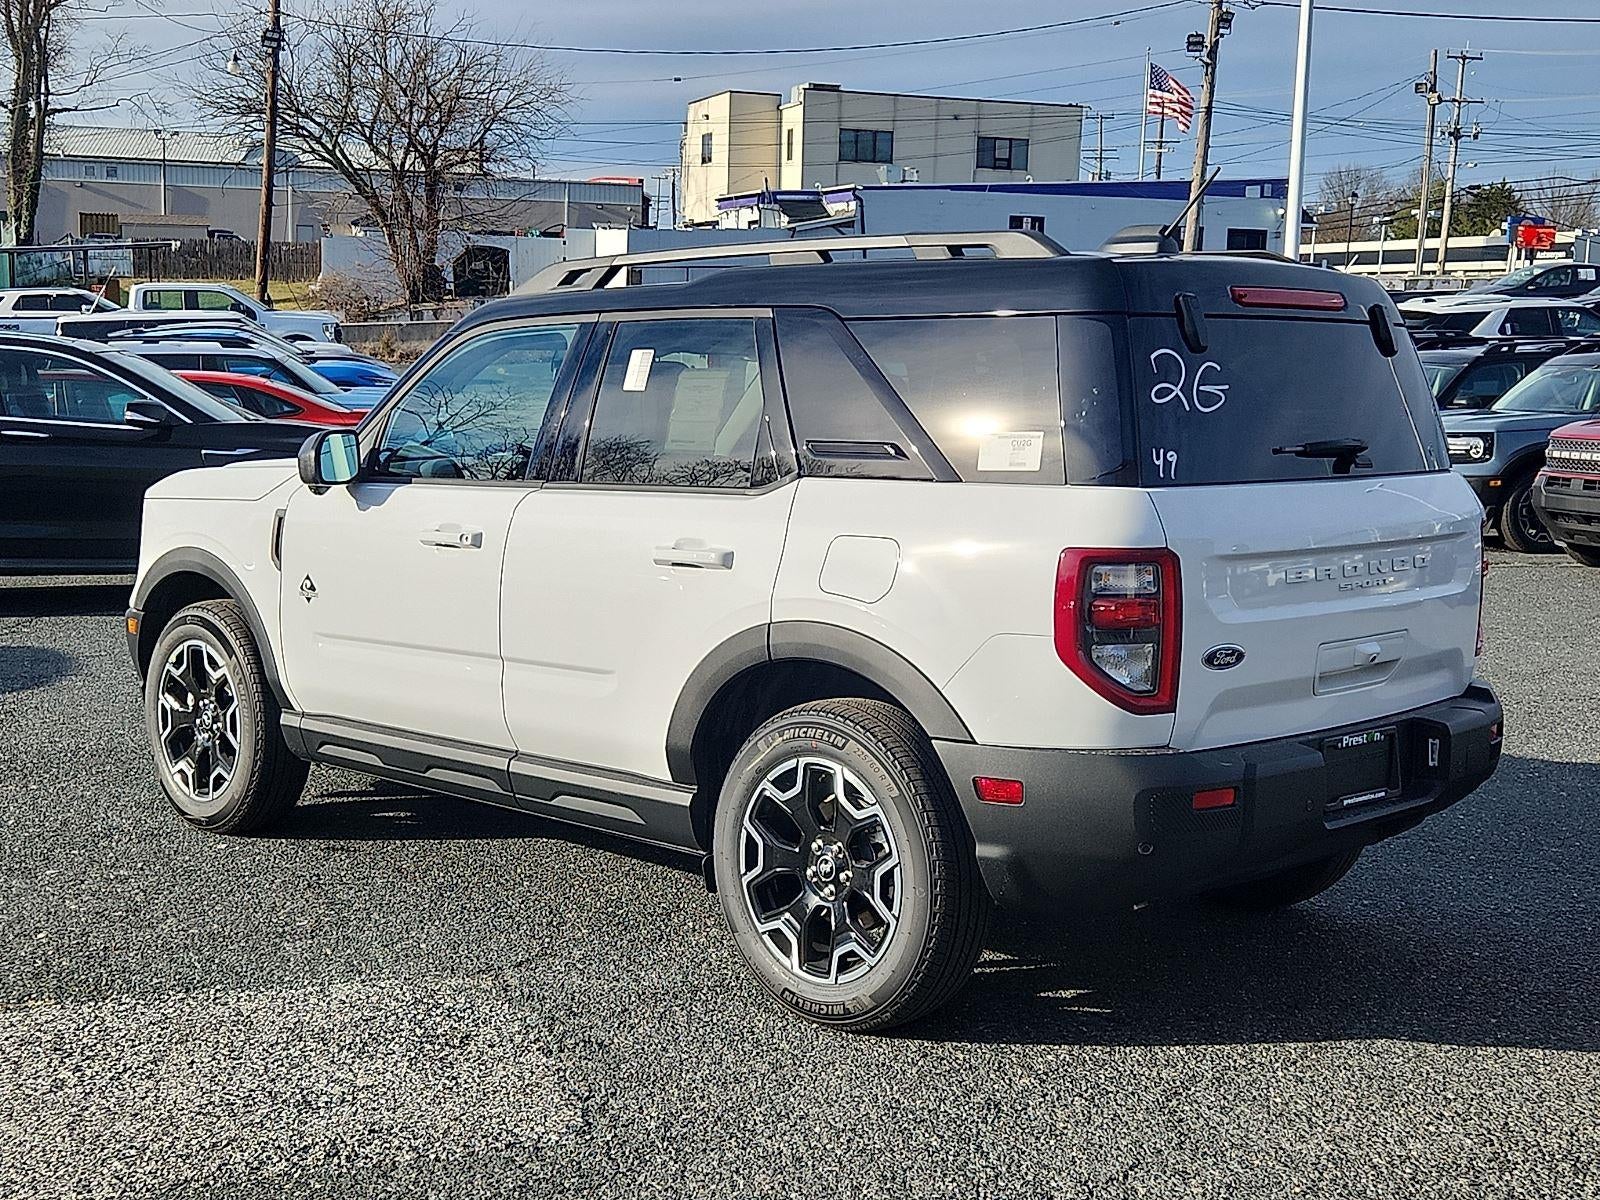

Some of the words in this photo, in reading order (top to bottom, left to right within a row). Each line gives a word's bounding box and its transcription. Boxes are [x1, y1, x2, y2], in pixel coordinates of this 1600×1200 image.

[1150, 348, 1230, 413] 2G
[1011, 439, 1032, 447] CU2G
[1152, 447, 1178, 480] 49
[1285, 553, 1432, 584] BRONCO
[1338, 576, 1395, 591] SPORT
[1213, 650, 1241, 665] Ford
[782, 727, 846, 747] MICHELIN
[1342, 731, 1380, 748] Preston
[852, 747, 880, 773] 225/60
[782, 990, 845, 1015] MICHELIN
